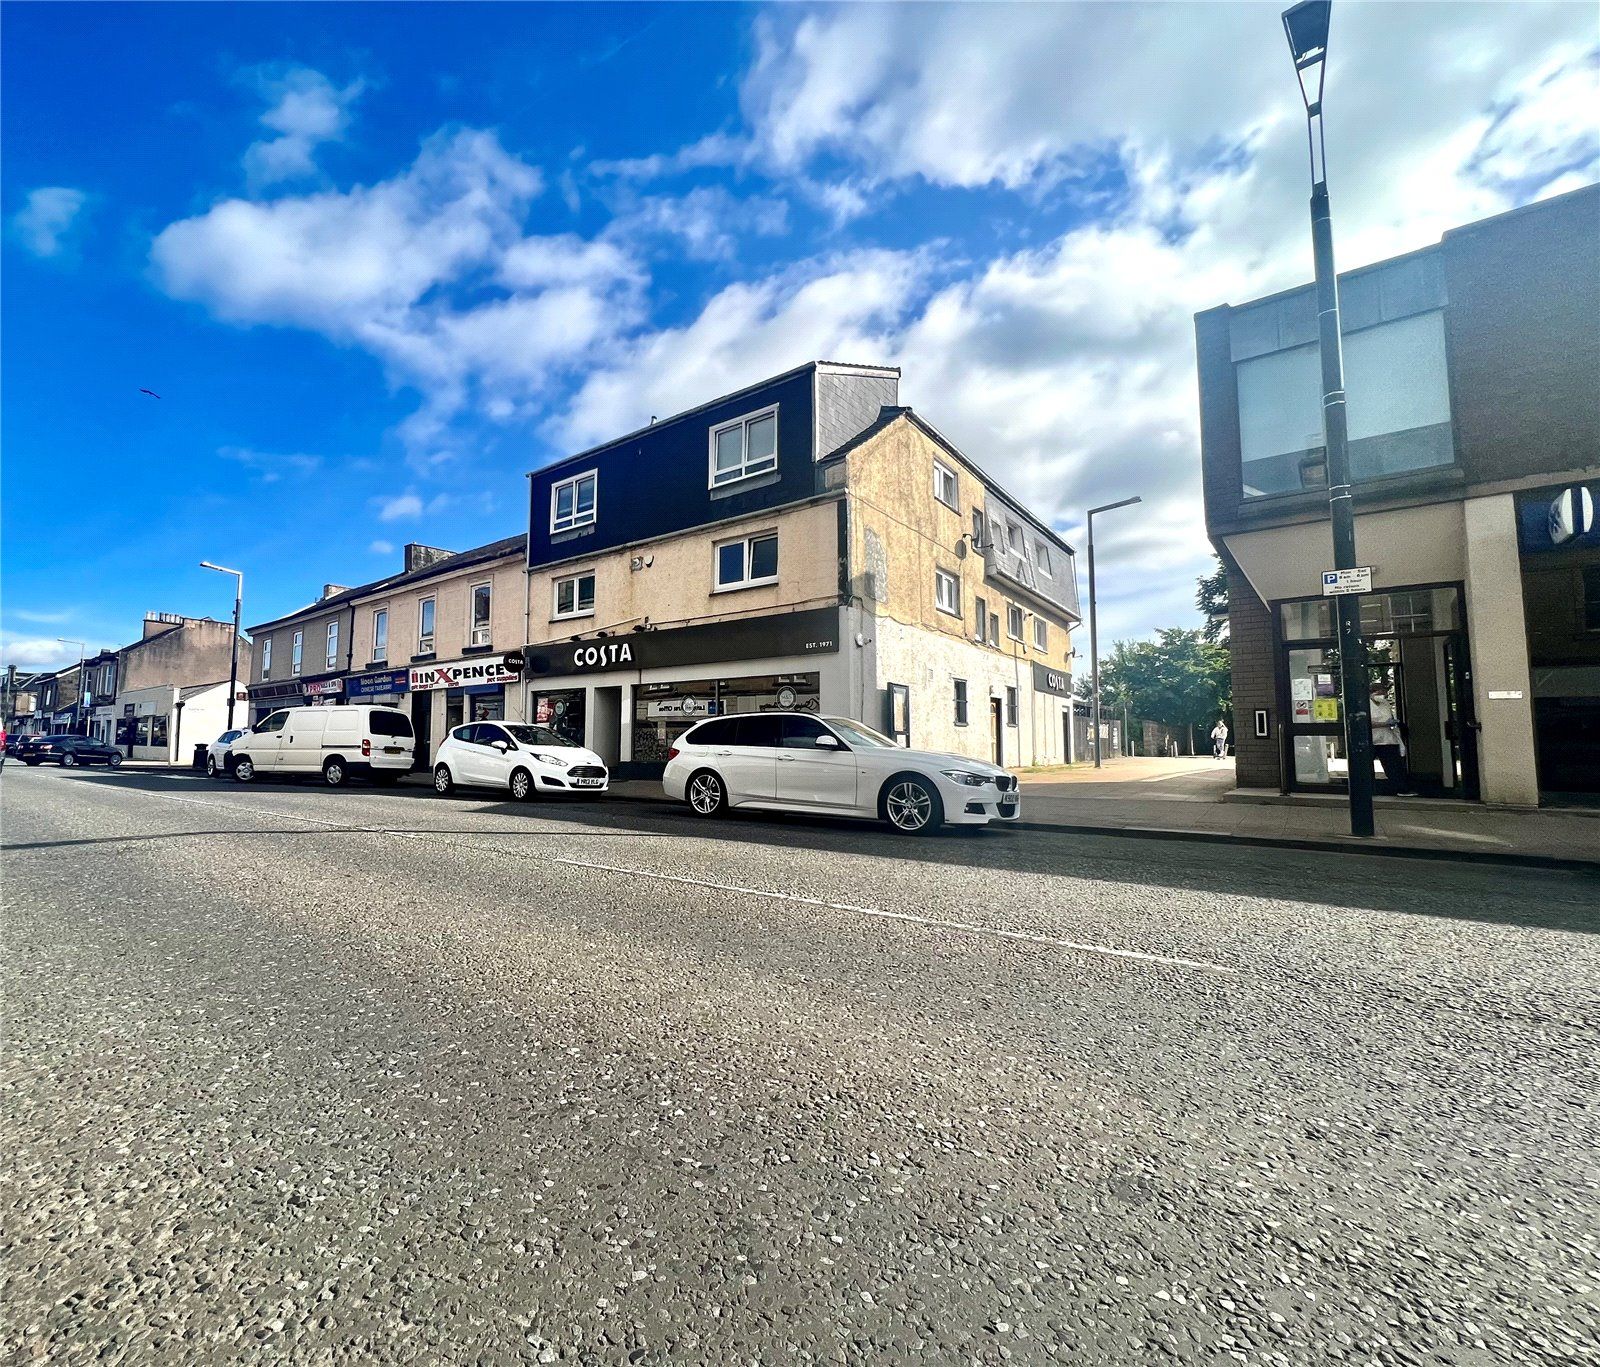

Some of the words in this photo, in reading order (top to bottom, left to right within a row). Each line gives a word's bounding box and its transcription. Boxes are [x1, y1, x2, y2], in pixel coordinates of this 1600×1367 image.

[1327, 575, 1336, 584] P
[574, 643, 632, 667] COSTA
[496, 674, 518, 682] supplies
[1048, 673, 1065, 691] COSTA
